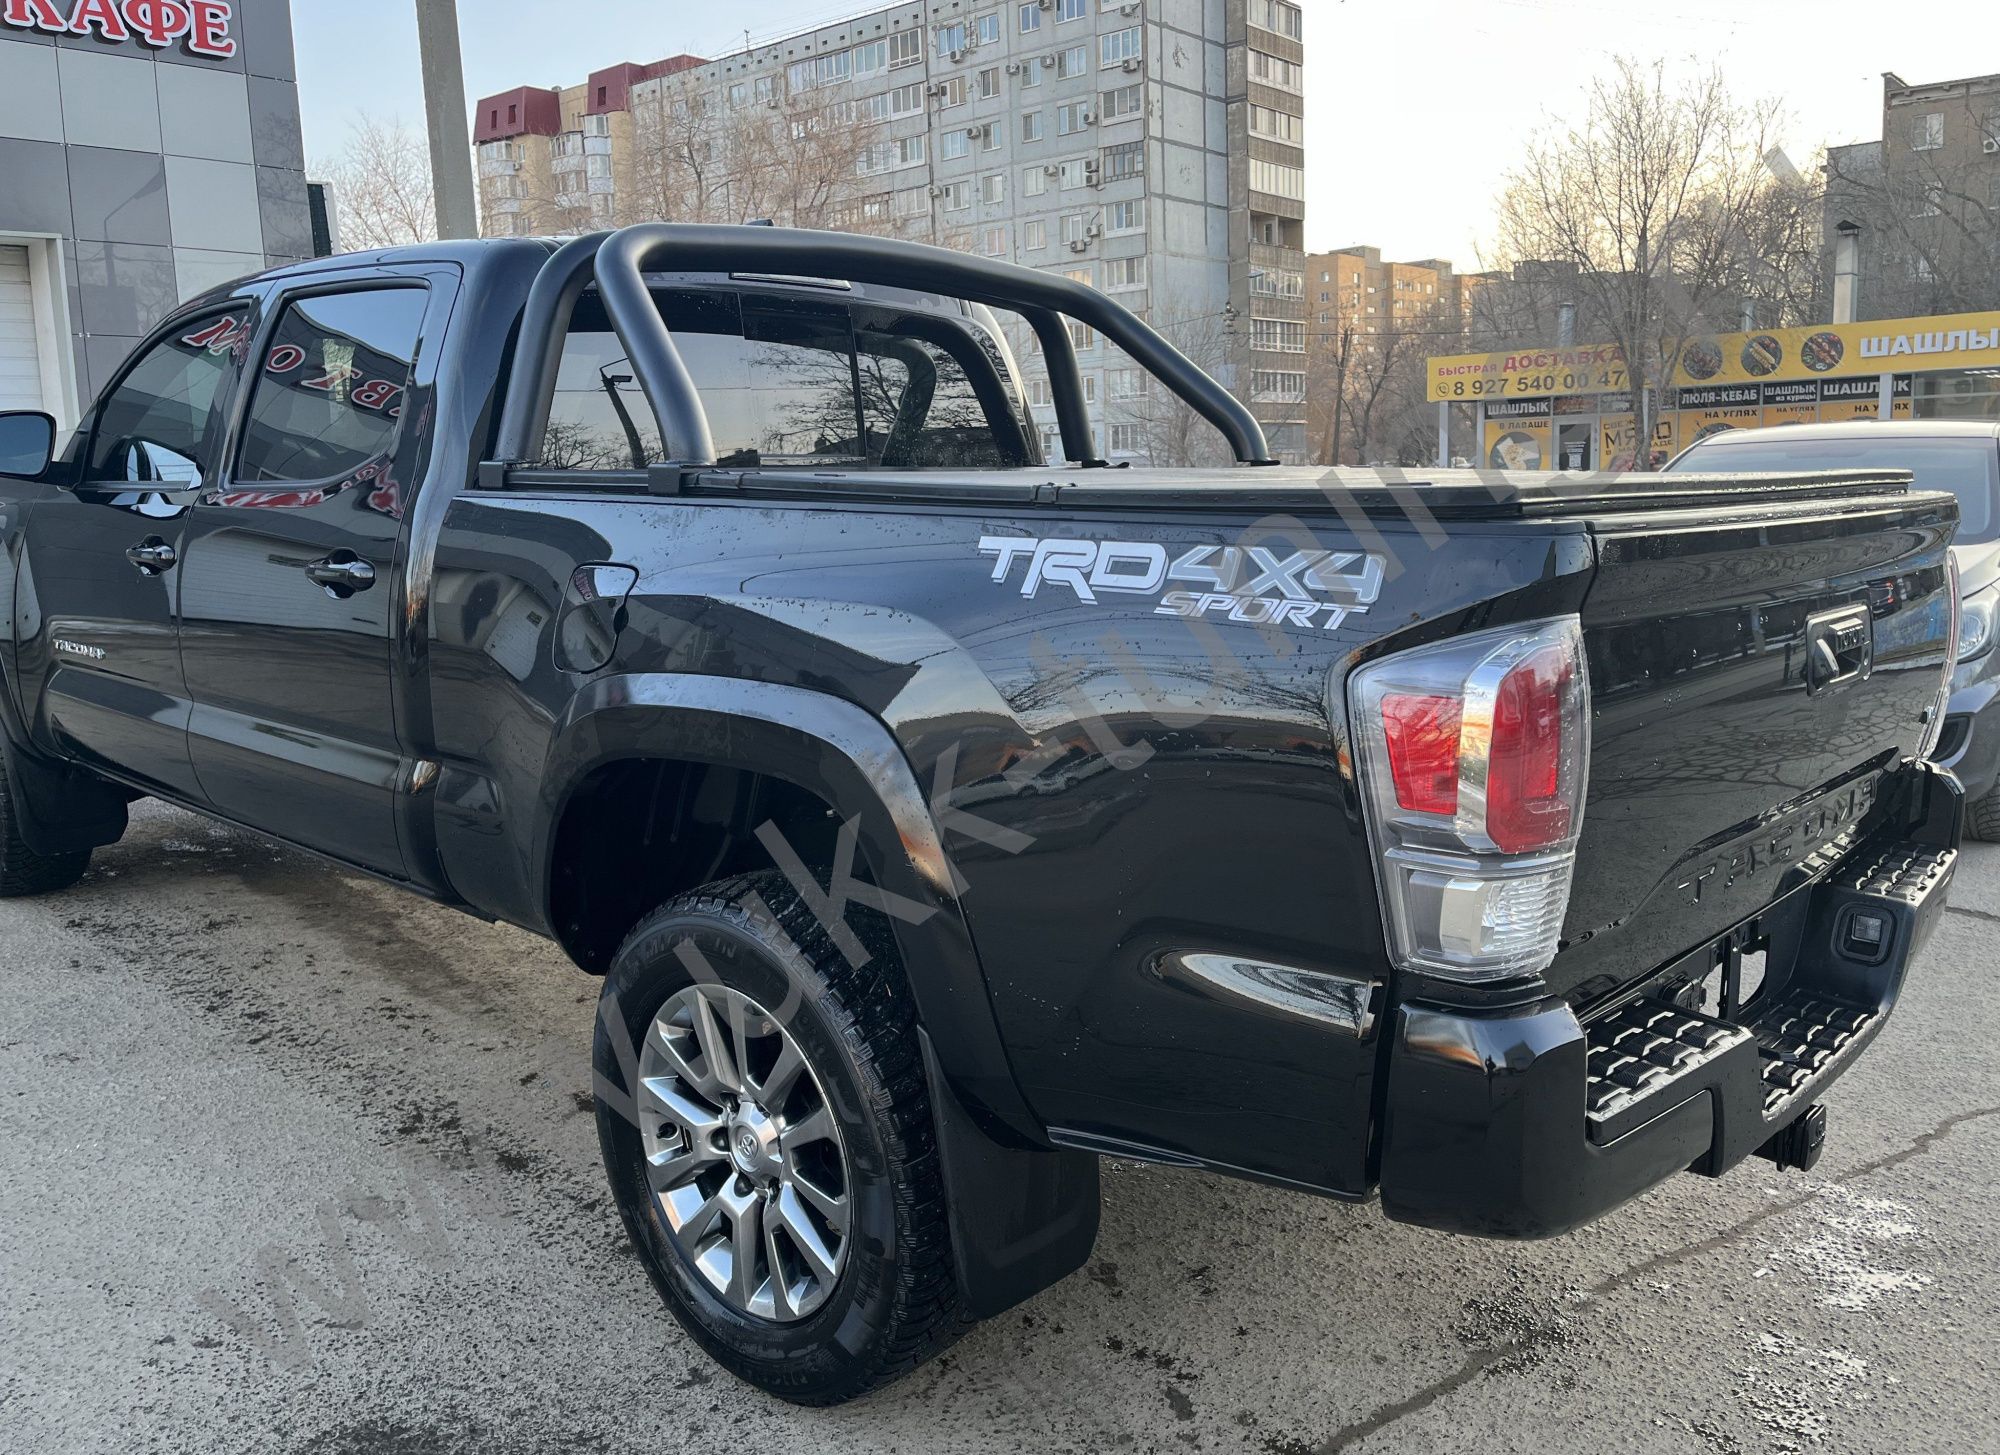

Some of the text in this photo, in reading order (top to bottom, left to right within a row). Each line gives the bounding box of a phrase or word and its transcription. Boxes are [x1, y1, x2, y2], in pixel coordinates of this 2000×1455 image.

[4, 0, 237, 58] КАФЕ
[1438, 347, 1628, 377] БЫСТРАЯ ДОСТАВКА
[1453, 369, 1625, 396] 8 927 540 00 47
[1764, 384, 1816, 396] ШАШЛЫК
[1823, 380, 1910, 396] ШАШЛК
[1681, 388, 1758, 405] ЛЮЛЯ-КЕБАБ
[1487, 401, 1549, 416] ШАШЛЫК
[1704, 408, 1758, 419] НА УГЛЯХ
[1854, 402, 1909, 413] НА УЯХ
[1508, 420, 1550, 429] ЛАВАШЕ
[1605, 421, 1672, 449] МЯО
[977, 535, 1169, 605] TRD
[1153, 590, 1371, 630] SPORT
[52, 638, 106, 661] TACOMA
